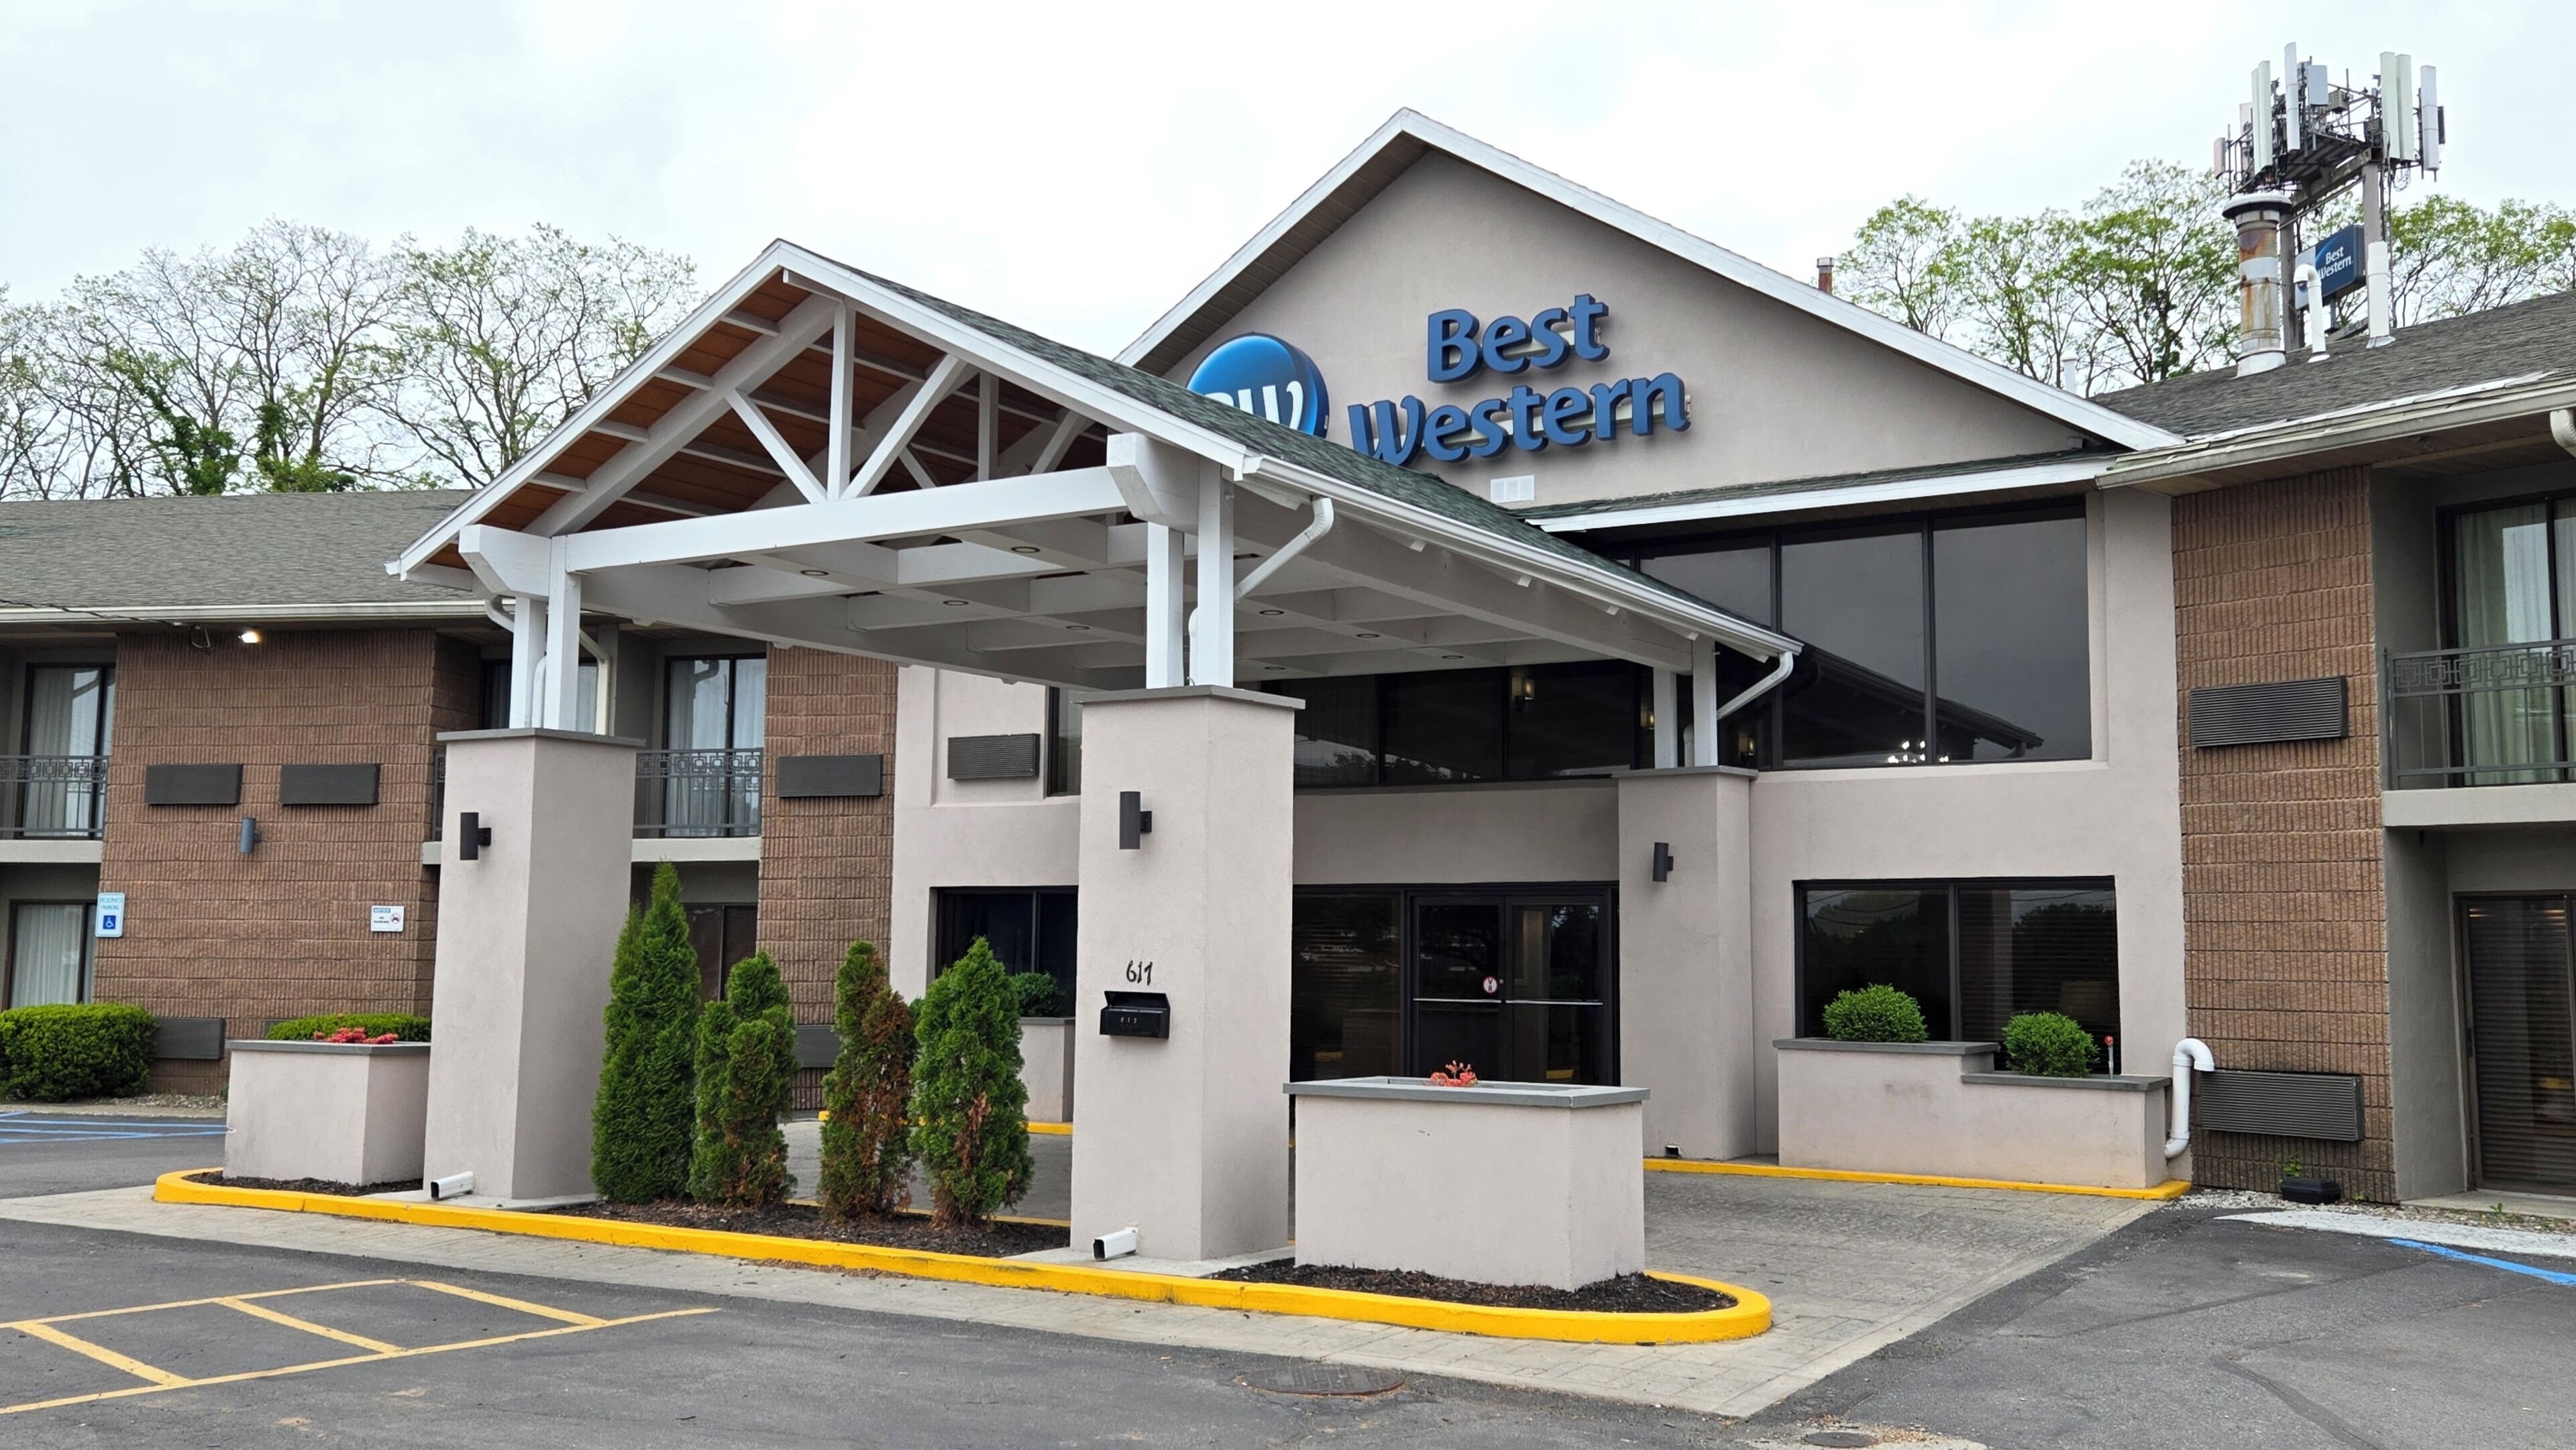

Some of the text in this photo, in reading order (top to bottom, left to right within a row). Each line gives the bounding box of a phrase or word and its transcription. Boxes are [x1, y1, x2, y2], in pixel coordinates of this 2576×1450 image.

[2326, 246, 2344, 265] Best
[1428, 293, 1610, 383] Best
[1348, 372, 1691, 466] Western
[1126, 960, 1153, 986] 617
